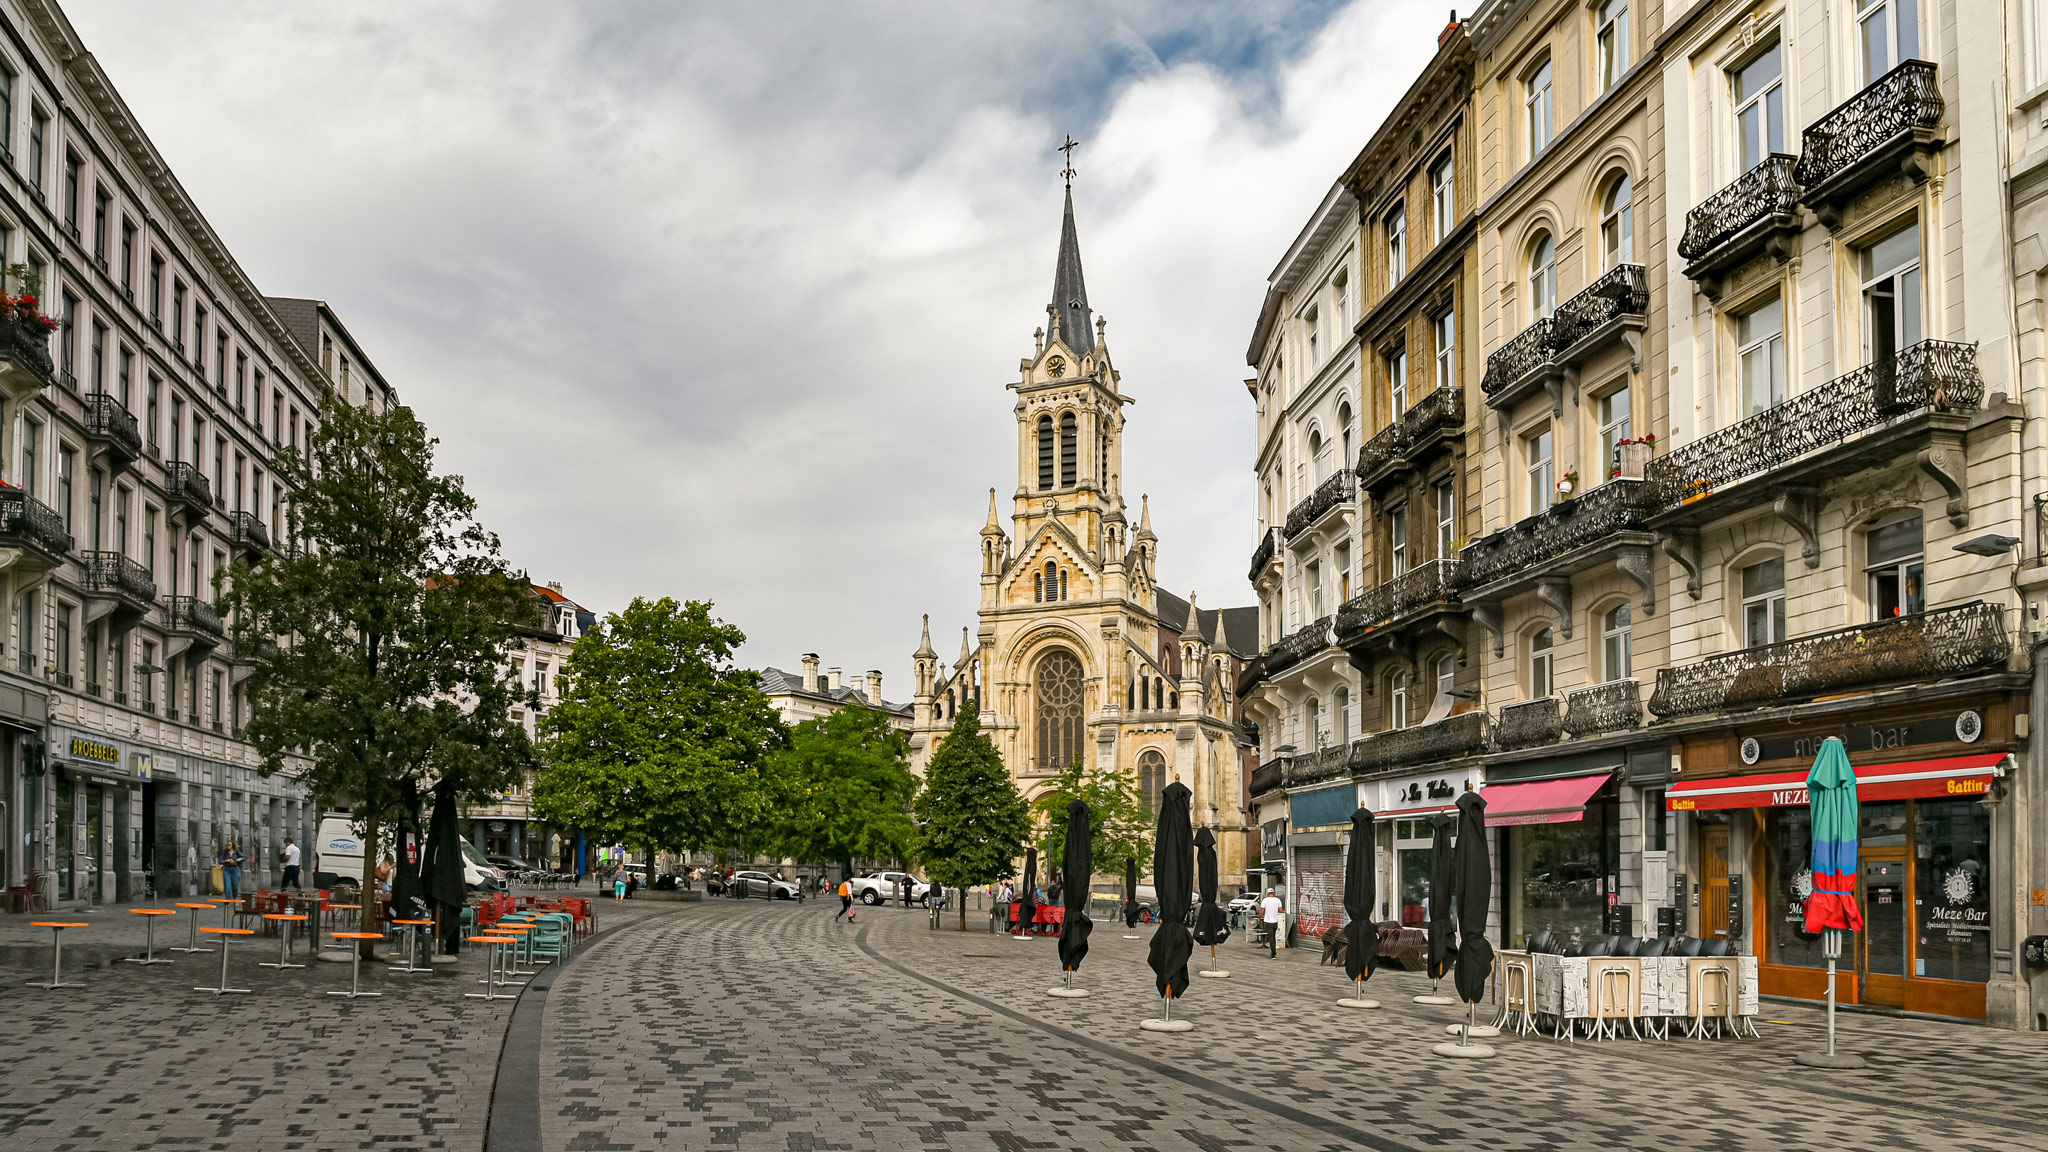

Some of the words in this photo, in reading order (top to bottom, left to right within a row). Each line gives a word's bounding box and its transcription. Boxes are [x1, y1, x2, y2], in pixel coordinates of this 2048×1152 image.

[1795, 733, 1848, 757] mee
[1870, 724, 1909, 751] bar
[137, 755, 151, 779] M
[1947, 780, 1983, 793] Battin
[1672, 799, 1695, 810] Battin
[1771, 790, 1810, 805] MEZE
[1789, 902, 1803, 914] Me
[1932, 906, 1962, 920] Meze
[1964, 907, 1987, 921] Bar
